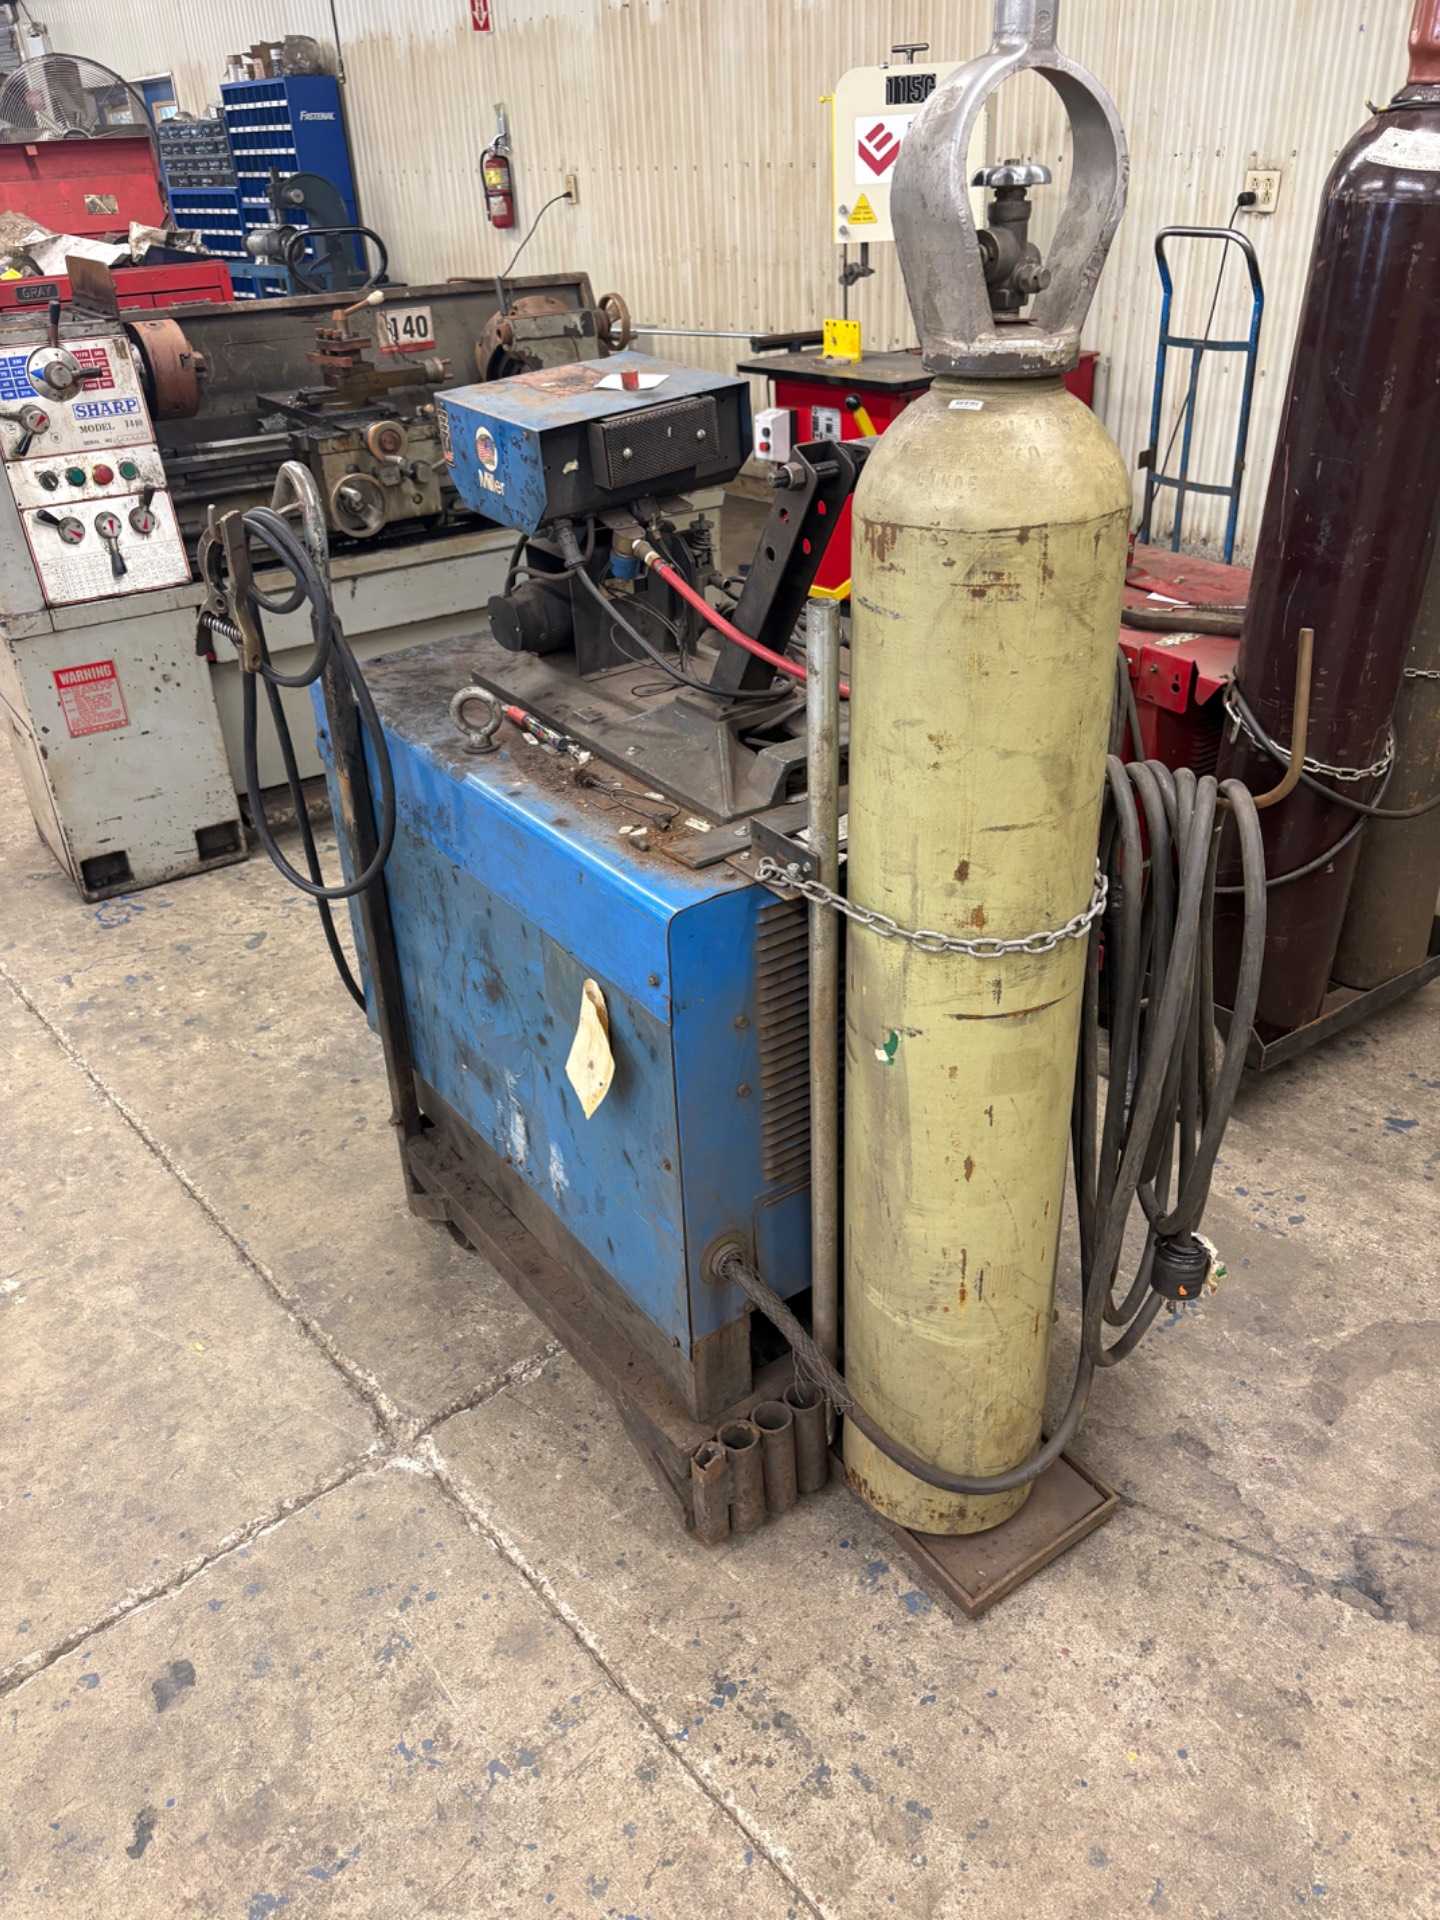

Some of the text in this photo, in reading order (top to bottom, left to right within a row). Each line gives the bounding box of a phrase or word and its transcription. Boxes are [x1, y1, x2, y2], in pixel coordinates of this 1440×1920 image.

[389, 315, 428, 341] 140
[75, 399, 137, 418] SHARP
[79, 422, 114, 434] MODEL
[59, 664, 112, 685] WARNING
